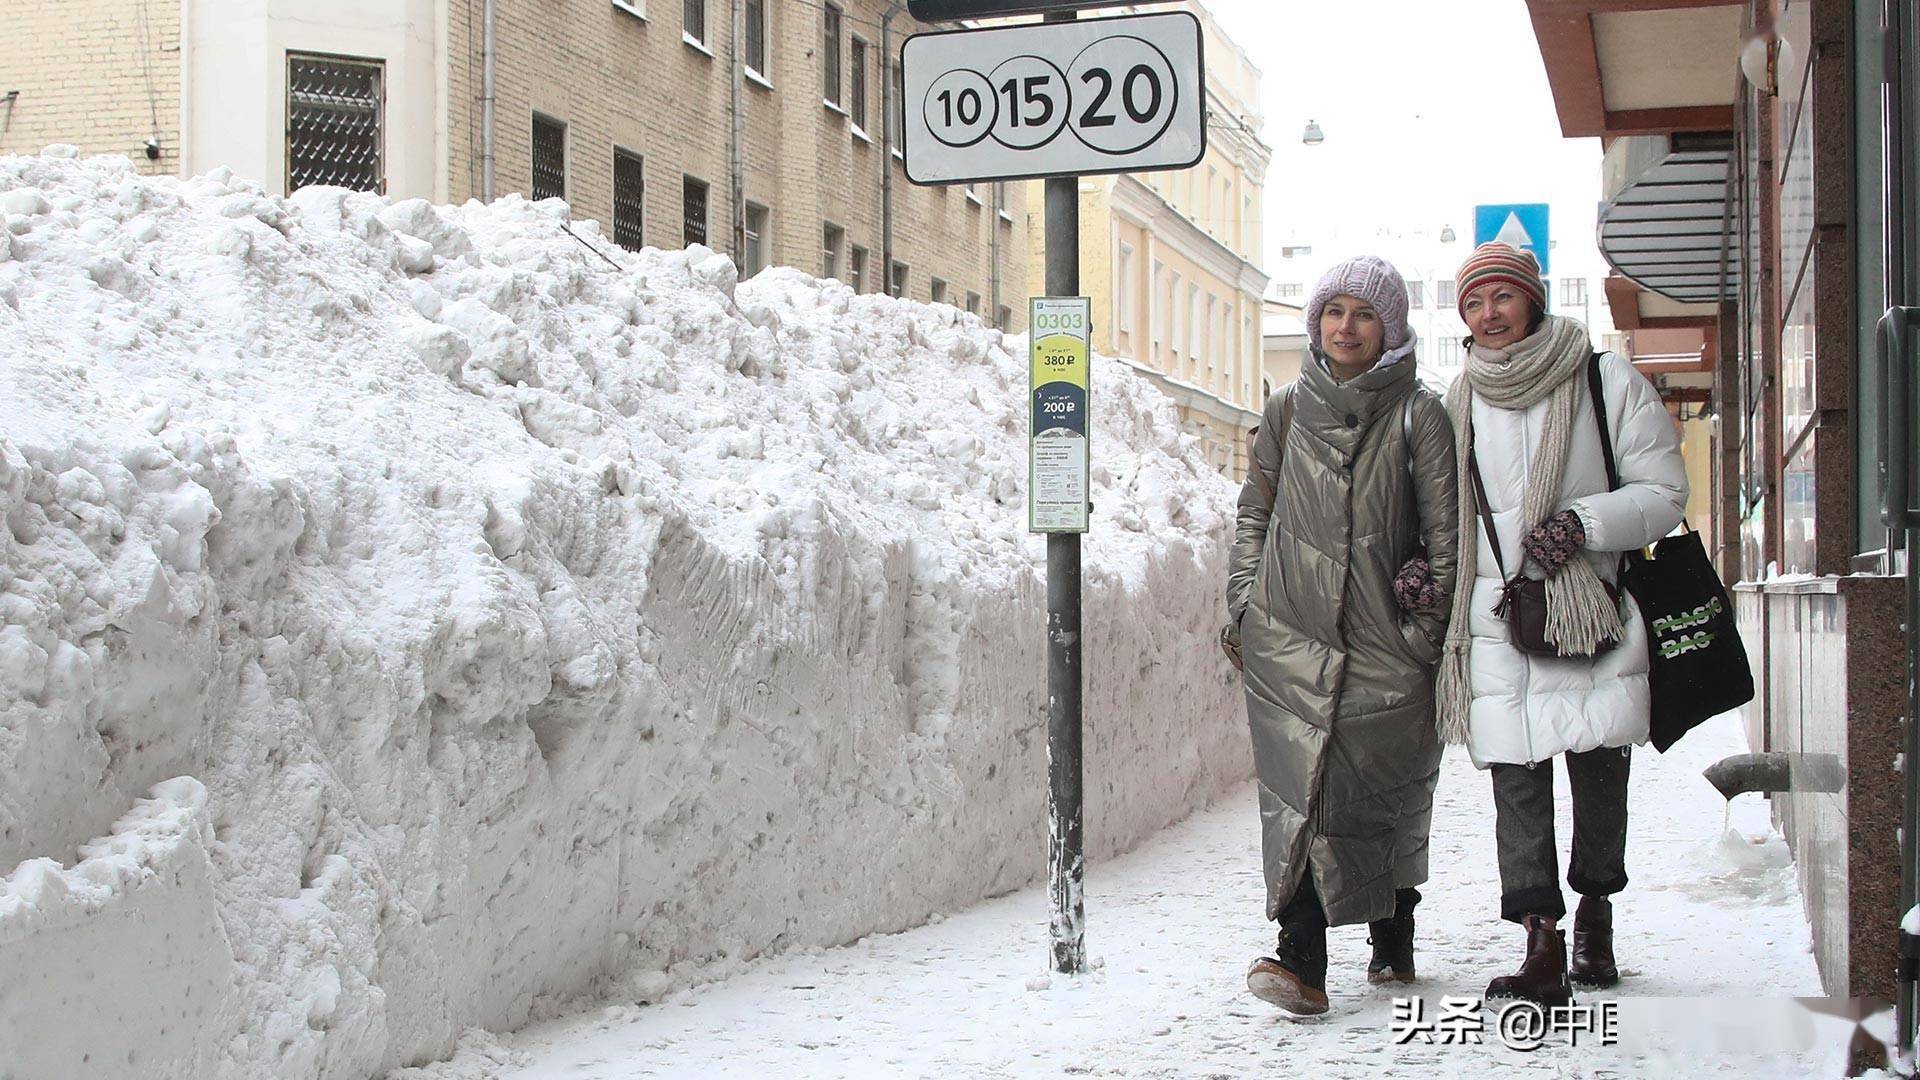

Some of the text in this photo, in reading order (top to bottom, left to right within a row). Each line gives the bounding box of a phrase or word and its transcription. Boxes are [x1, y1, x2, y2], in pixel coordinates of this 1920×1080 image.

[937, 64, 1162, 128] 10 15 20
[1037, 313, 1082, 329] 0303
